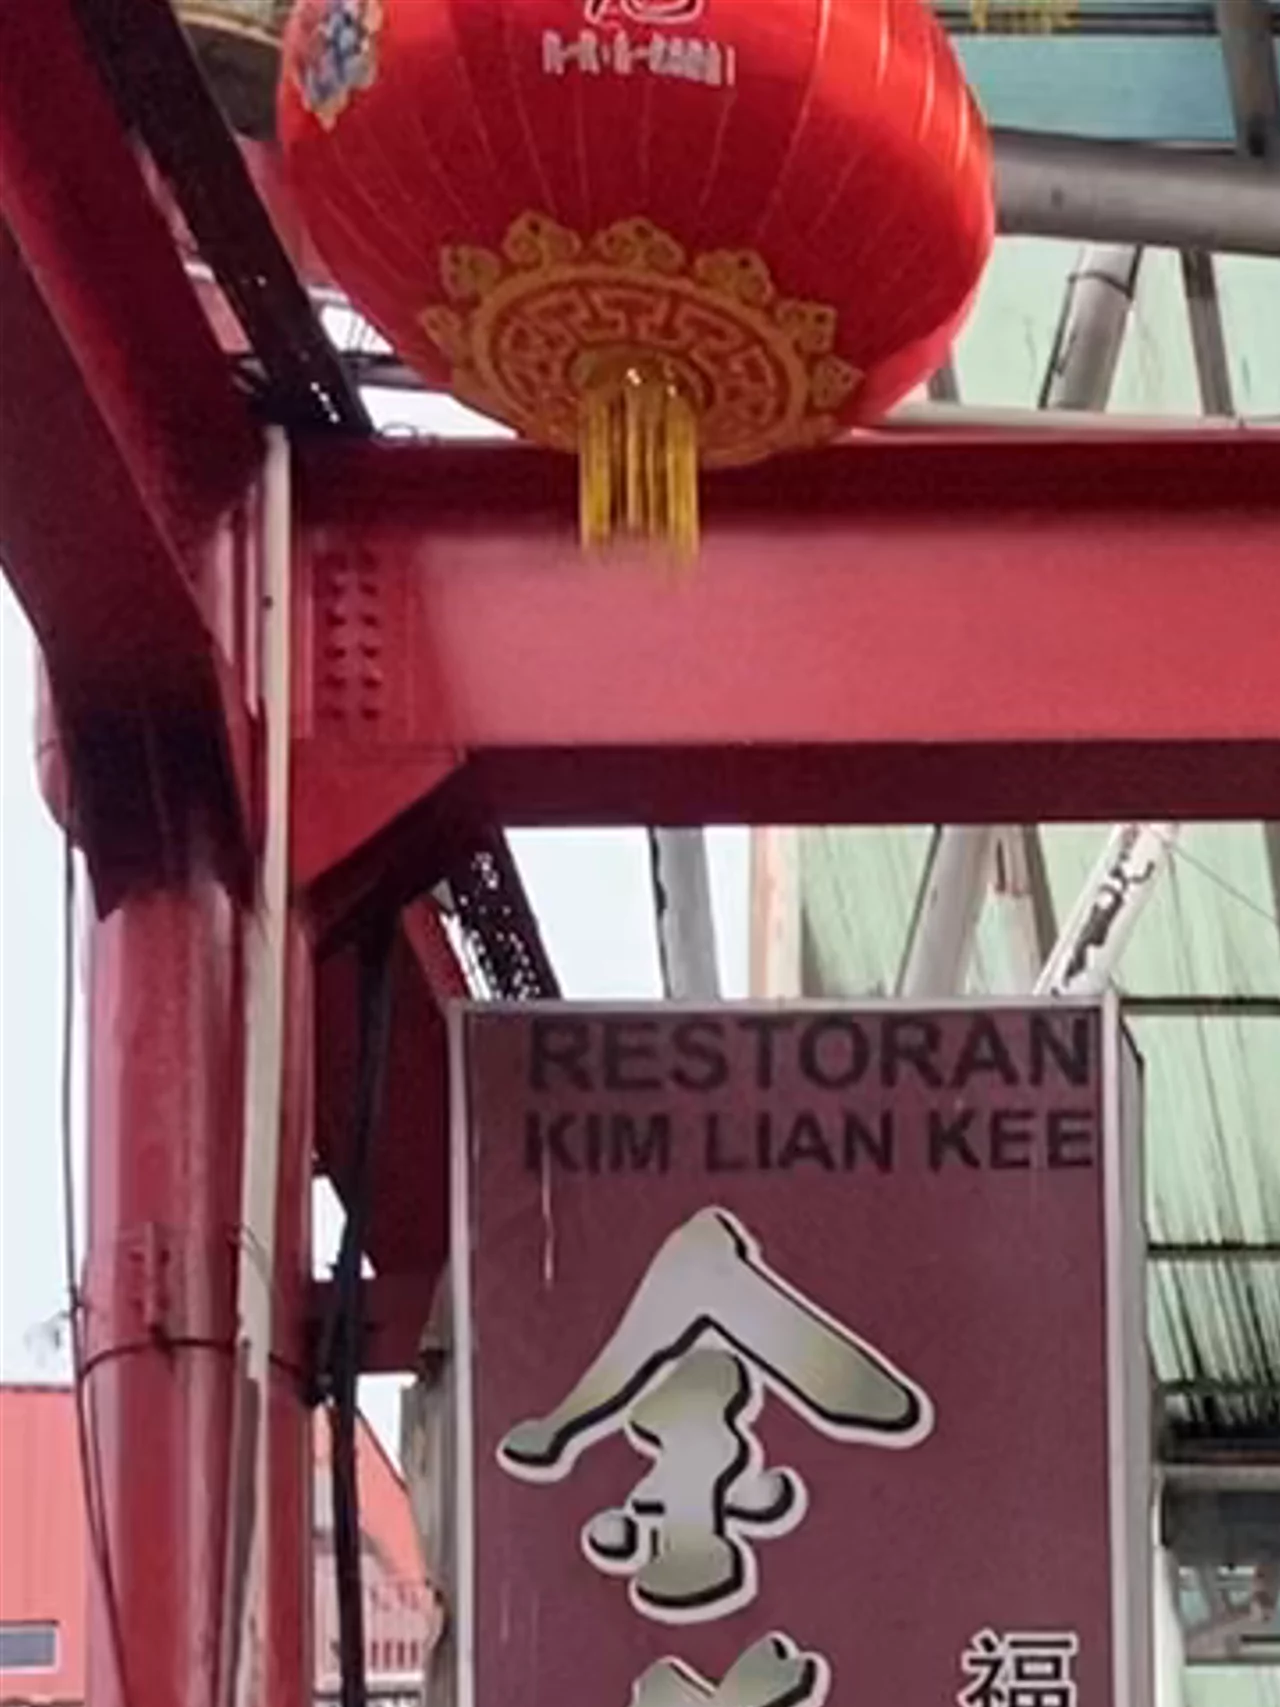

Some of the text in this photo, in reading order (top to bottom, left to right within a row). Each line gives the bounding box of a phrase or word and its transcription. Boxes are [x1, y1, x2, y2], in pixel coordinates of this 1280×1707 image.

[530, 1015, 1090, 1092] RESTORAN
[525, 1108, 1093, 1174] KIM LIAN KEE
